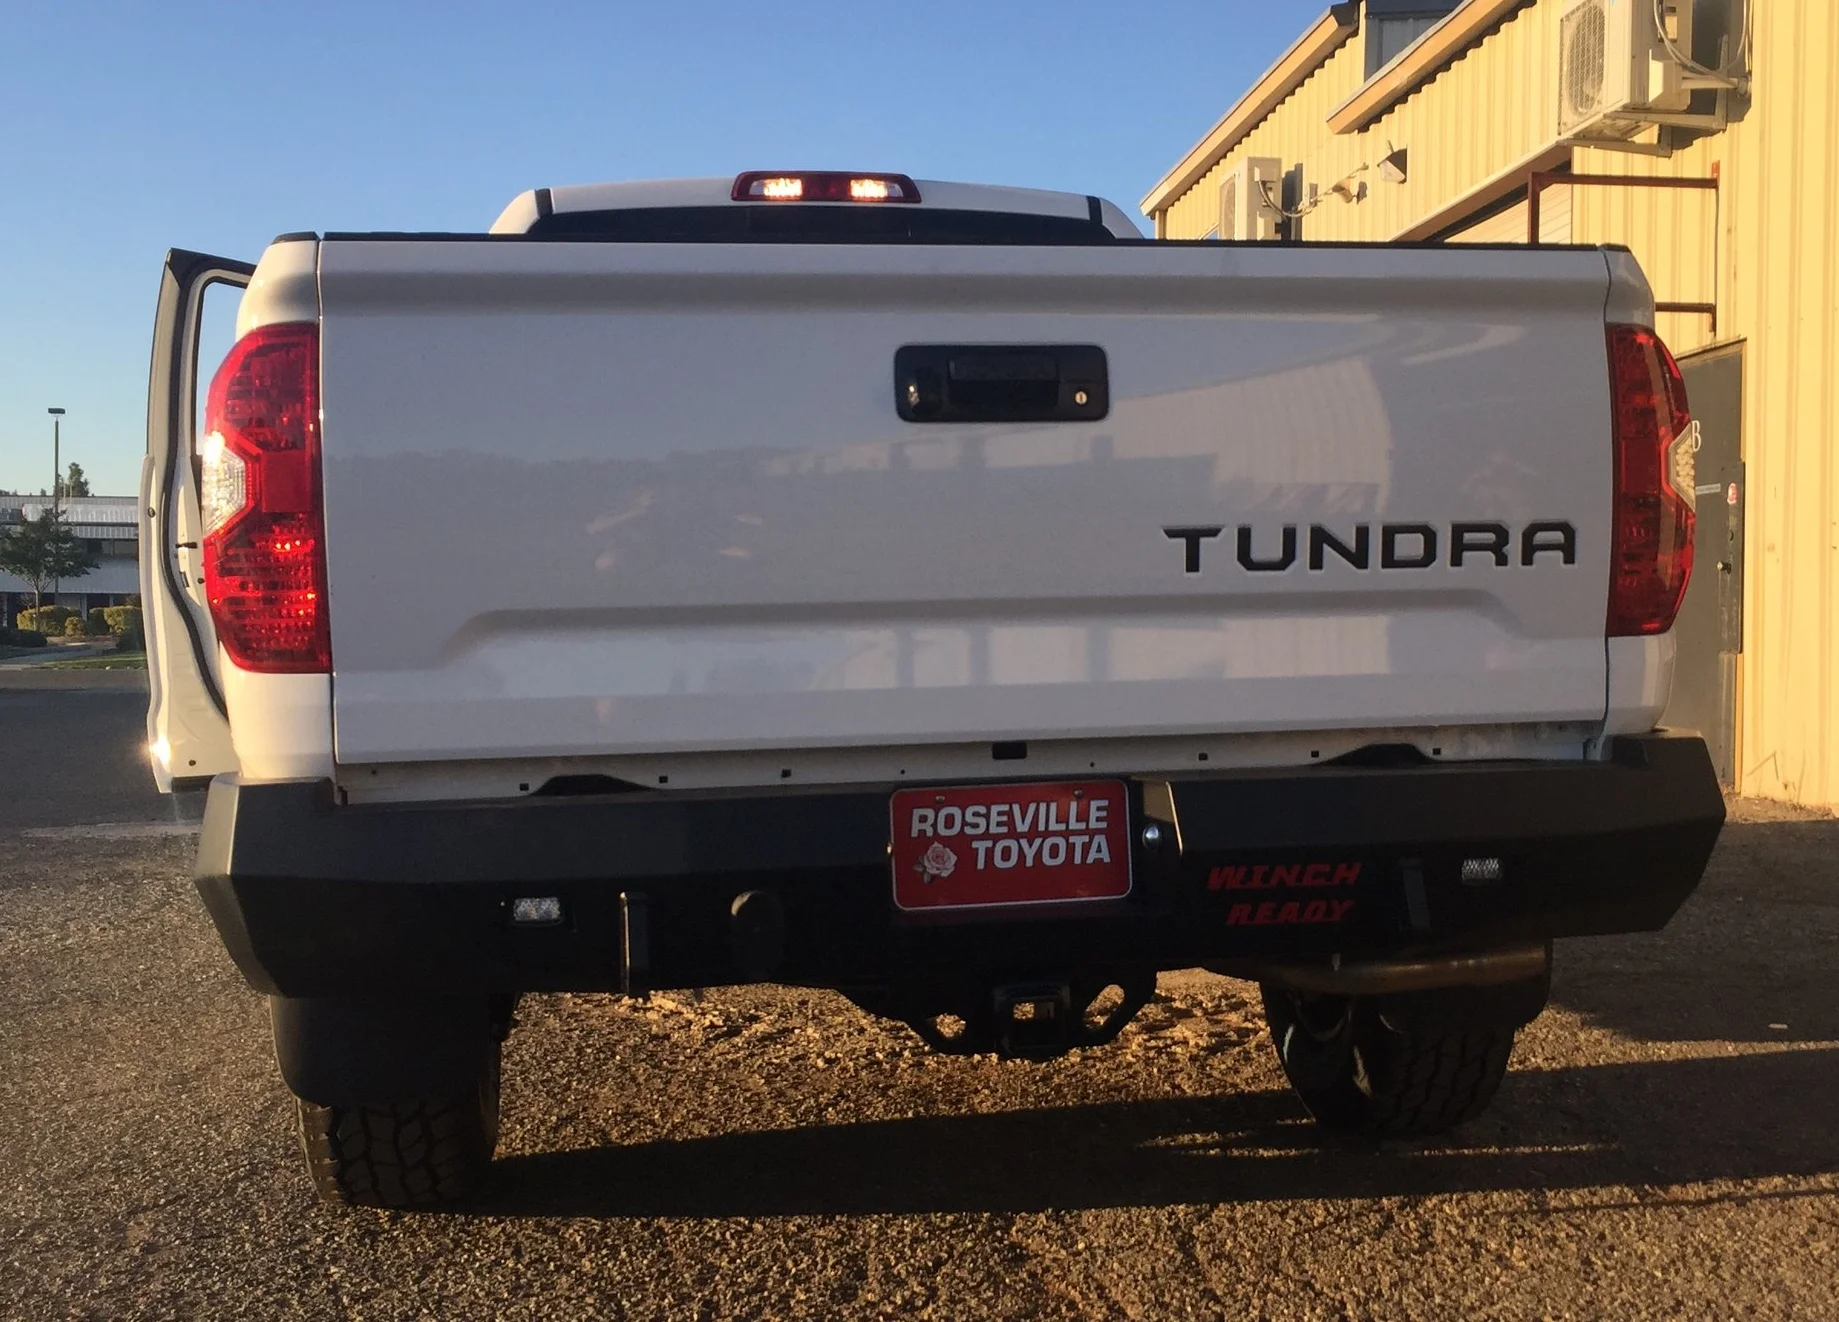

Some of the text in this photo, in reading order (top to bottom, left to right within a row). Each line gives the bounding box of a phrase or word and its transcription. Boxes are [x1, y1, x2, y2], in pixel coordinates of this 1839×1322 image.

[1163, 521, 1576, 573] TUNDRA
[911, 800, 1109, 838] ROSEVILLE
[972, 834, 1111, 870] TOYOTA
[1207, 861, 1363, 891] WINCH
[1227, 900, 1355, 926] READY
